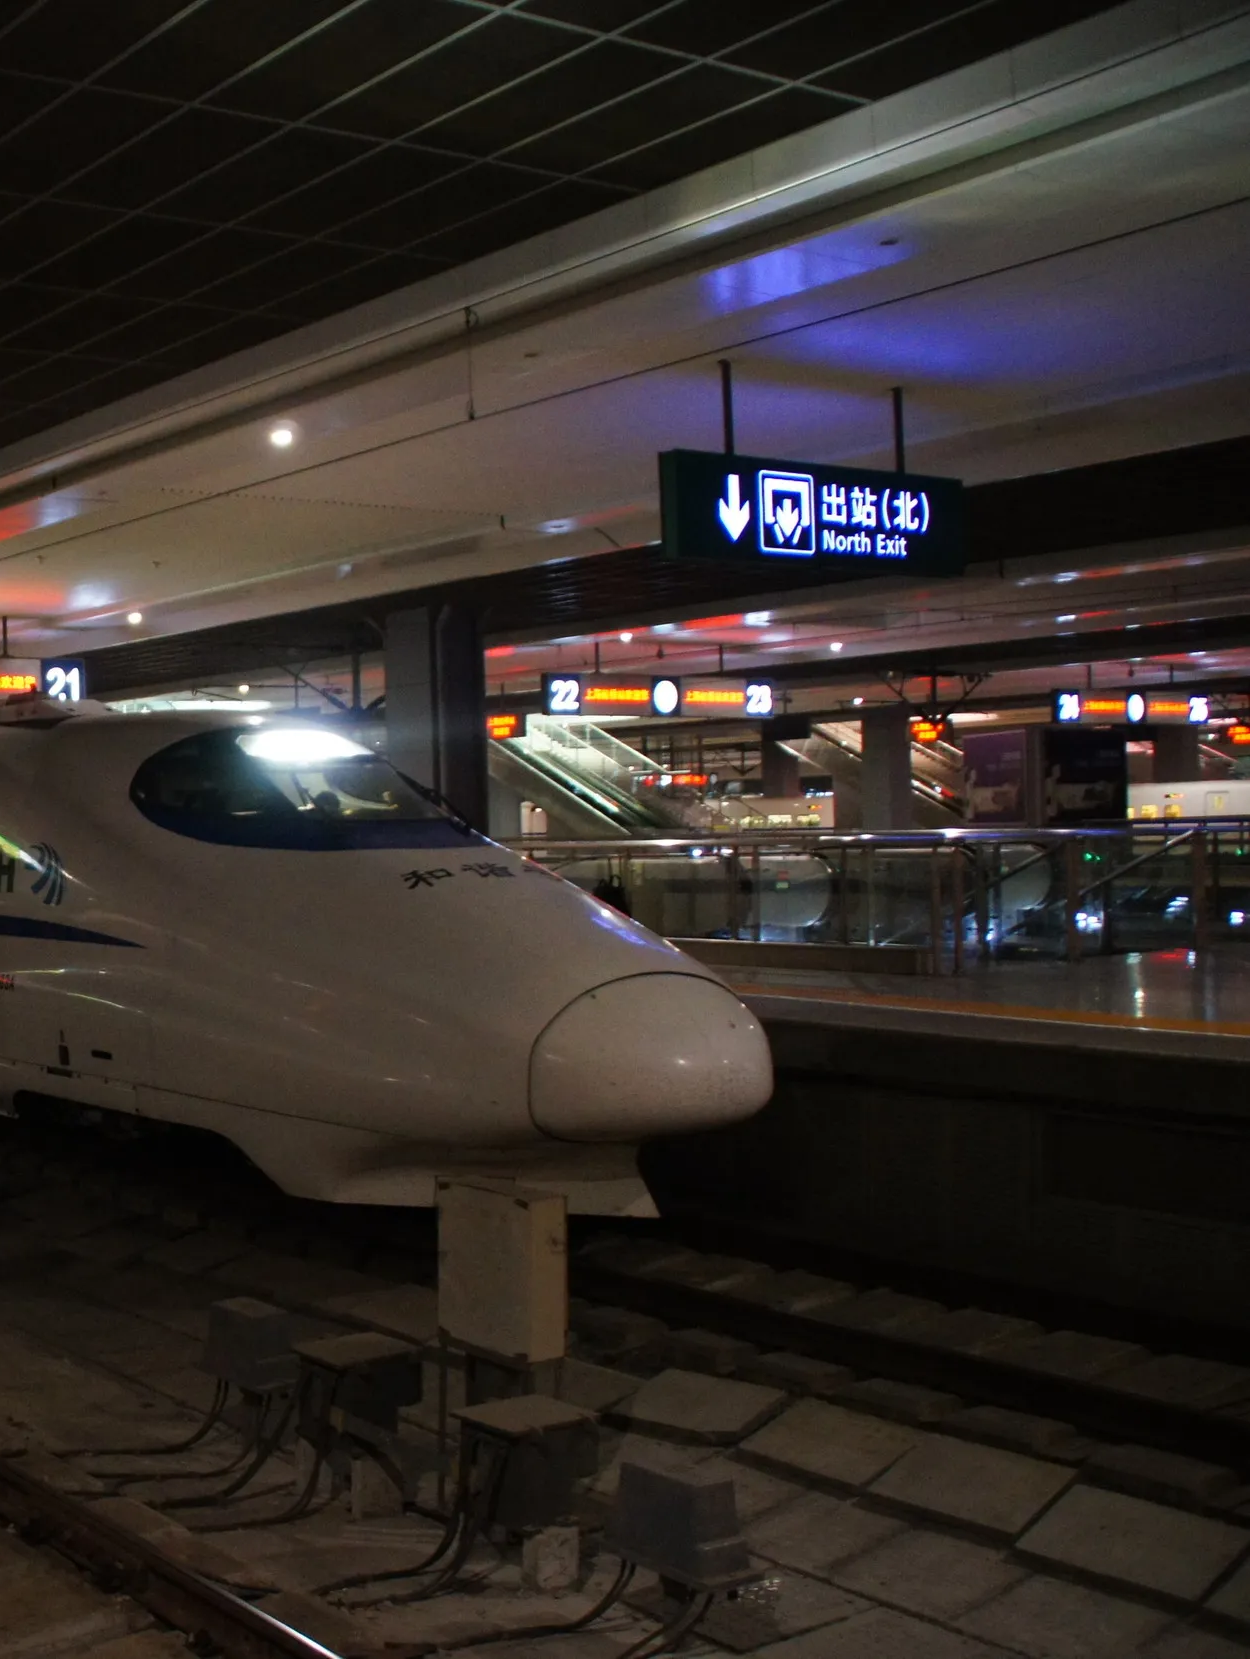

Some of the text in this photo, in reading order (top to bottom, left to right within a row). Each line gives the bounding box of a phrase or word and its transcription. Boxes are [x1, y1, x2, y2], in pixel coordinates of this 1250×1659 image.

[822, 483, 930, 532] 出站(北)
[822, 529, 908, 556] North Exit
[46, 667, 80, 702] 21
[550, 679, 580, 711] 22
[746, 684, 773, 714] 23
